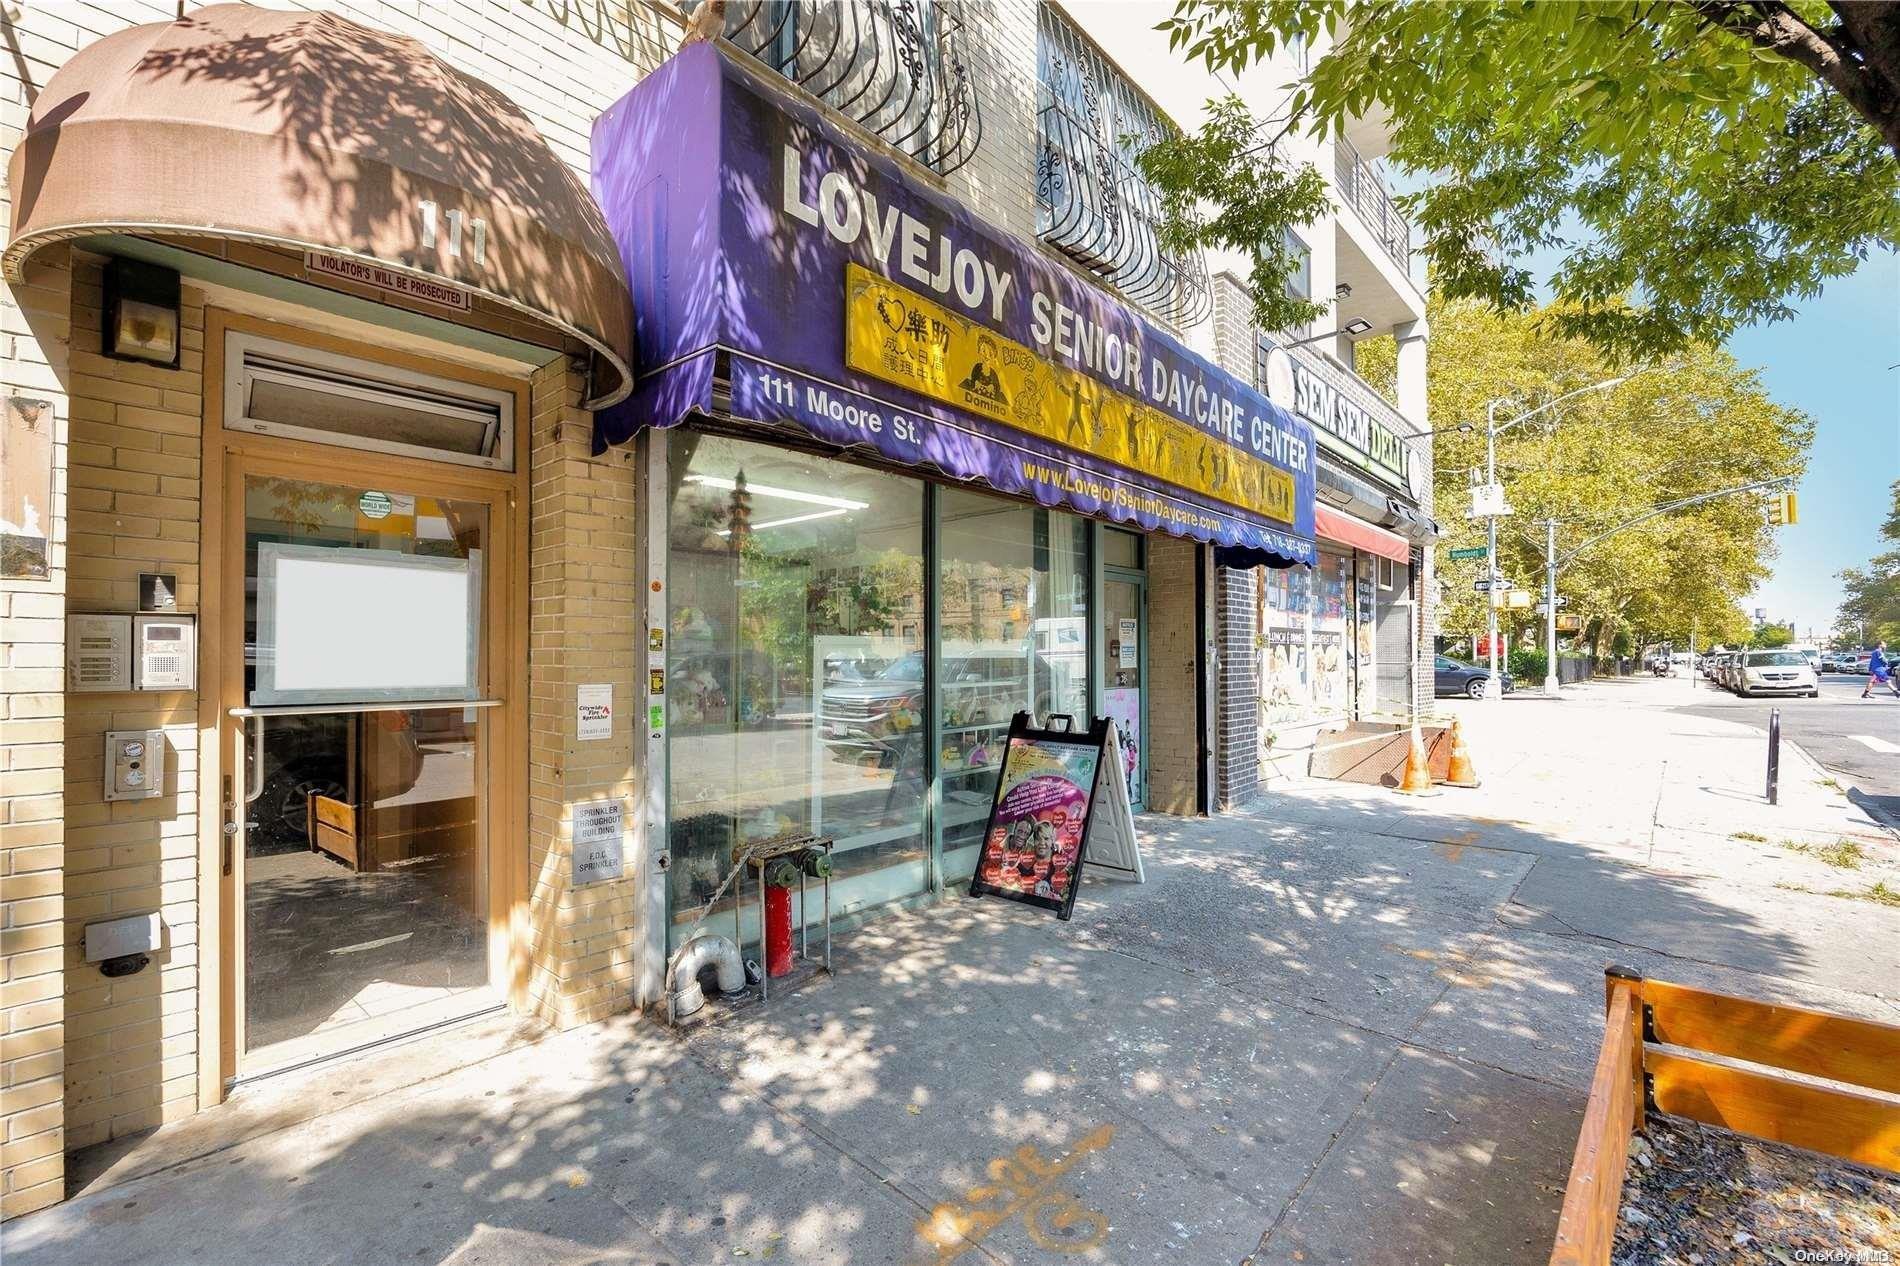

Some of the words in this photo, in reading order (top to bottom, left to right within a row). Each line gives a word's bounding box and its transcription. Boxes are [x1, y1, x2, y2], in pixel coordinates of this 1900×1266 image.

[418, 200, 486, 265] 111
[320, 255, 370, 279] VIOLATOR'S
[374, 269, 393, 286] WILL
[396, 276, 408, 290] BE
[411, 280, 461, 304] PROSECUTED
[784, 144, 1011, 322] LOVEJOY
[1030, 291, 1142, 392] SENIOR
[1152, 358, 1244, 443] DAYCARE
[1251, 416, 1308, 473] CENTER
[1001, 345, 1035, 373] BINGO
[759, 374, 794, 407] 111
[807, 386, 882, 433] Moore
[893, 415, 921, 445] St.
[964, 390, 1007, 417] Domino
[1297, 366, 1336, 432] SEM
[1337, 397, 1370, 454] SEM
[1023, 461, 1221, 532] www.LovejoySeniorDaycare.com
[575, 815, 622, 828] THROUGHOUT
[580, 806, 618, 817] SPRINKLER
[583, 825, 615, 837] BUILDING
[579, 859, 618, 873] SPRINKLER
